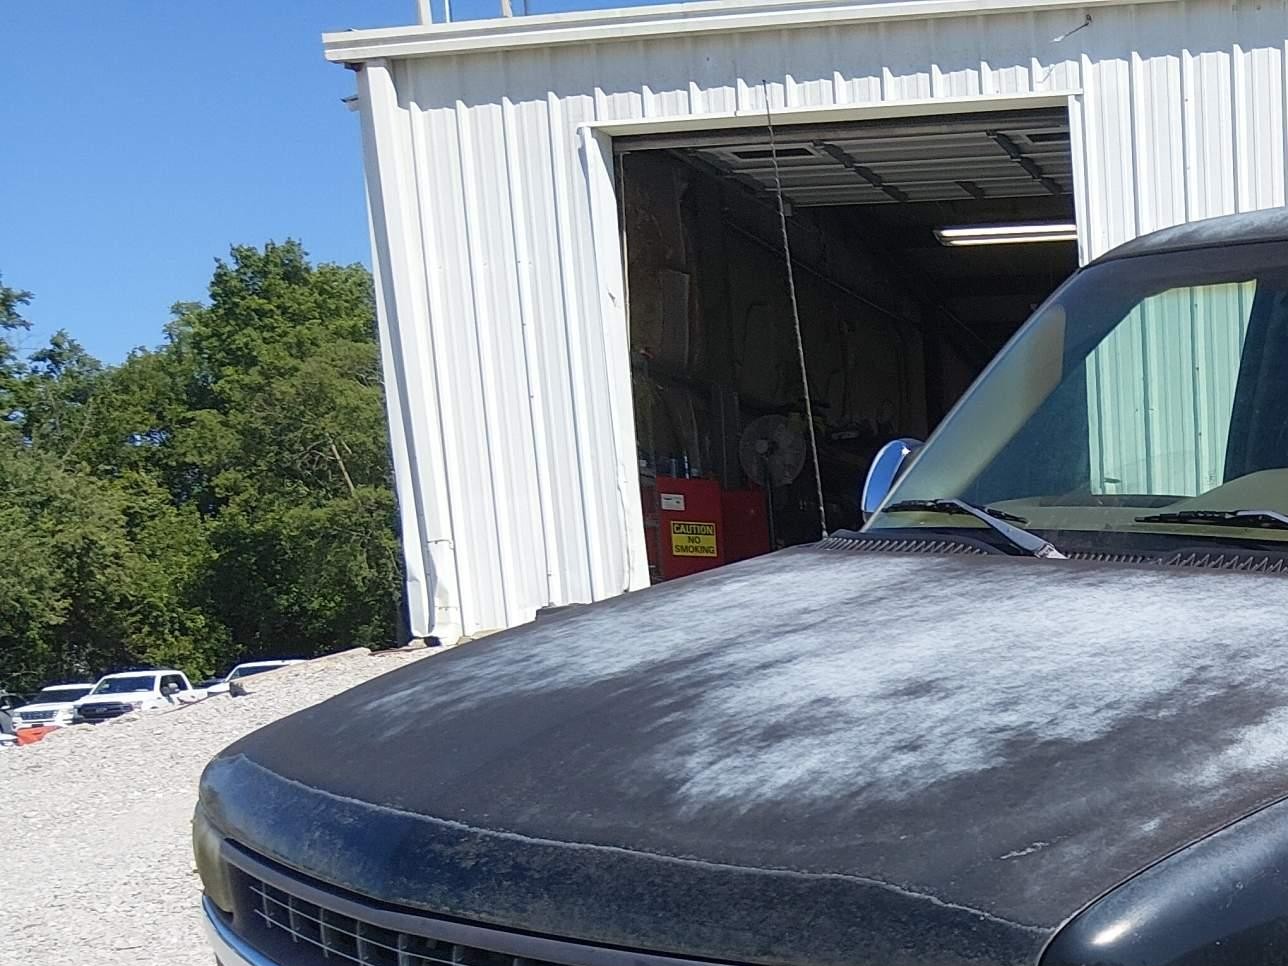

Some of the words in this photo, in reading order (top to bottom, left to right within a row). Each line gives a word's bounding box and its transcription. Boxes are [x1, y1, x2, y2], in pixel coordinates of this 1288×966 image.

[674, 525, 713, 534] CAUTION
[688, 536, 701, 544] NO
[675, 545, 714, 553] SMOKING
